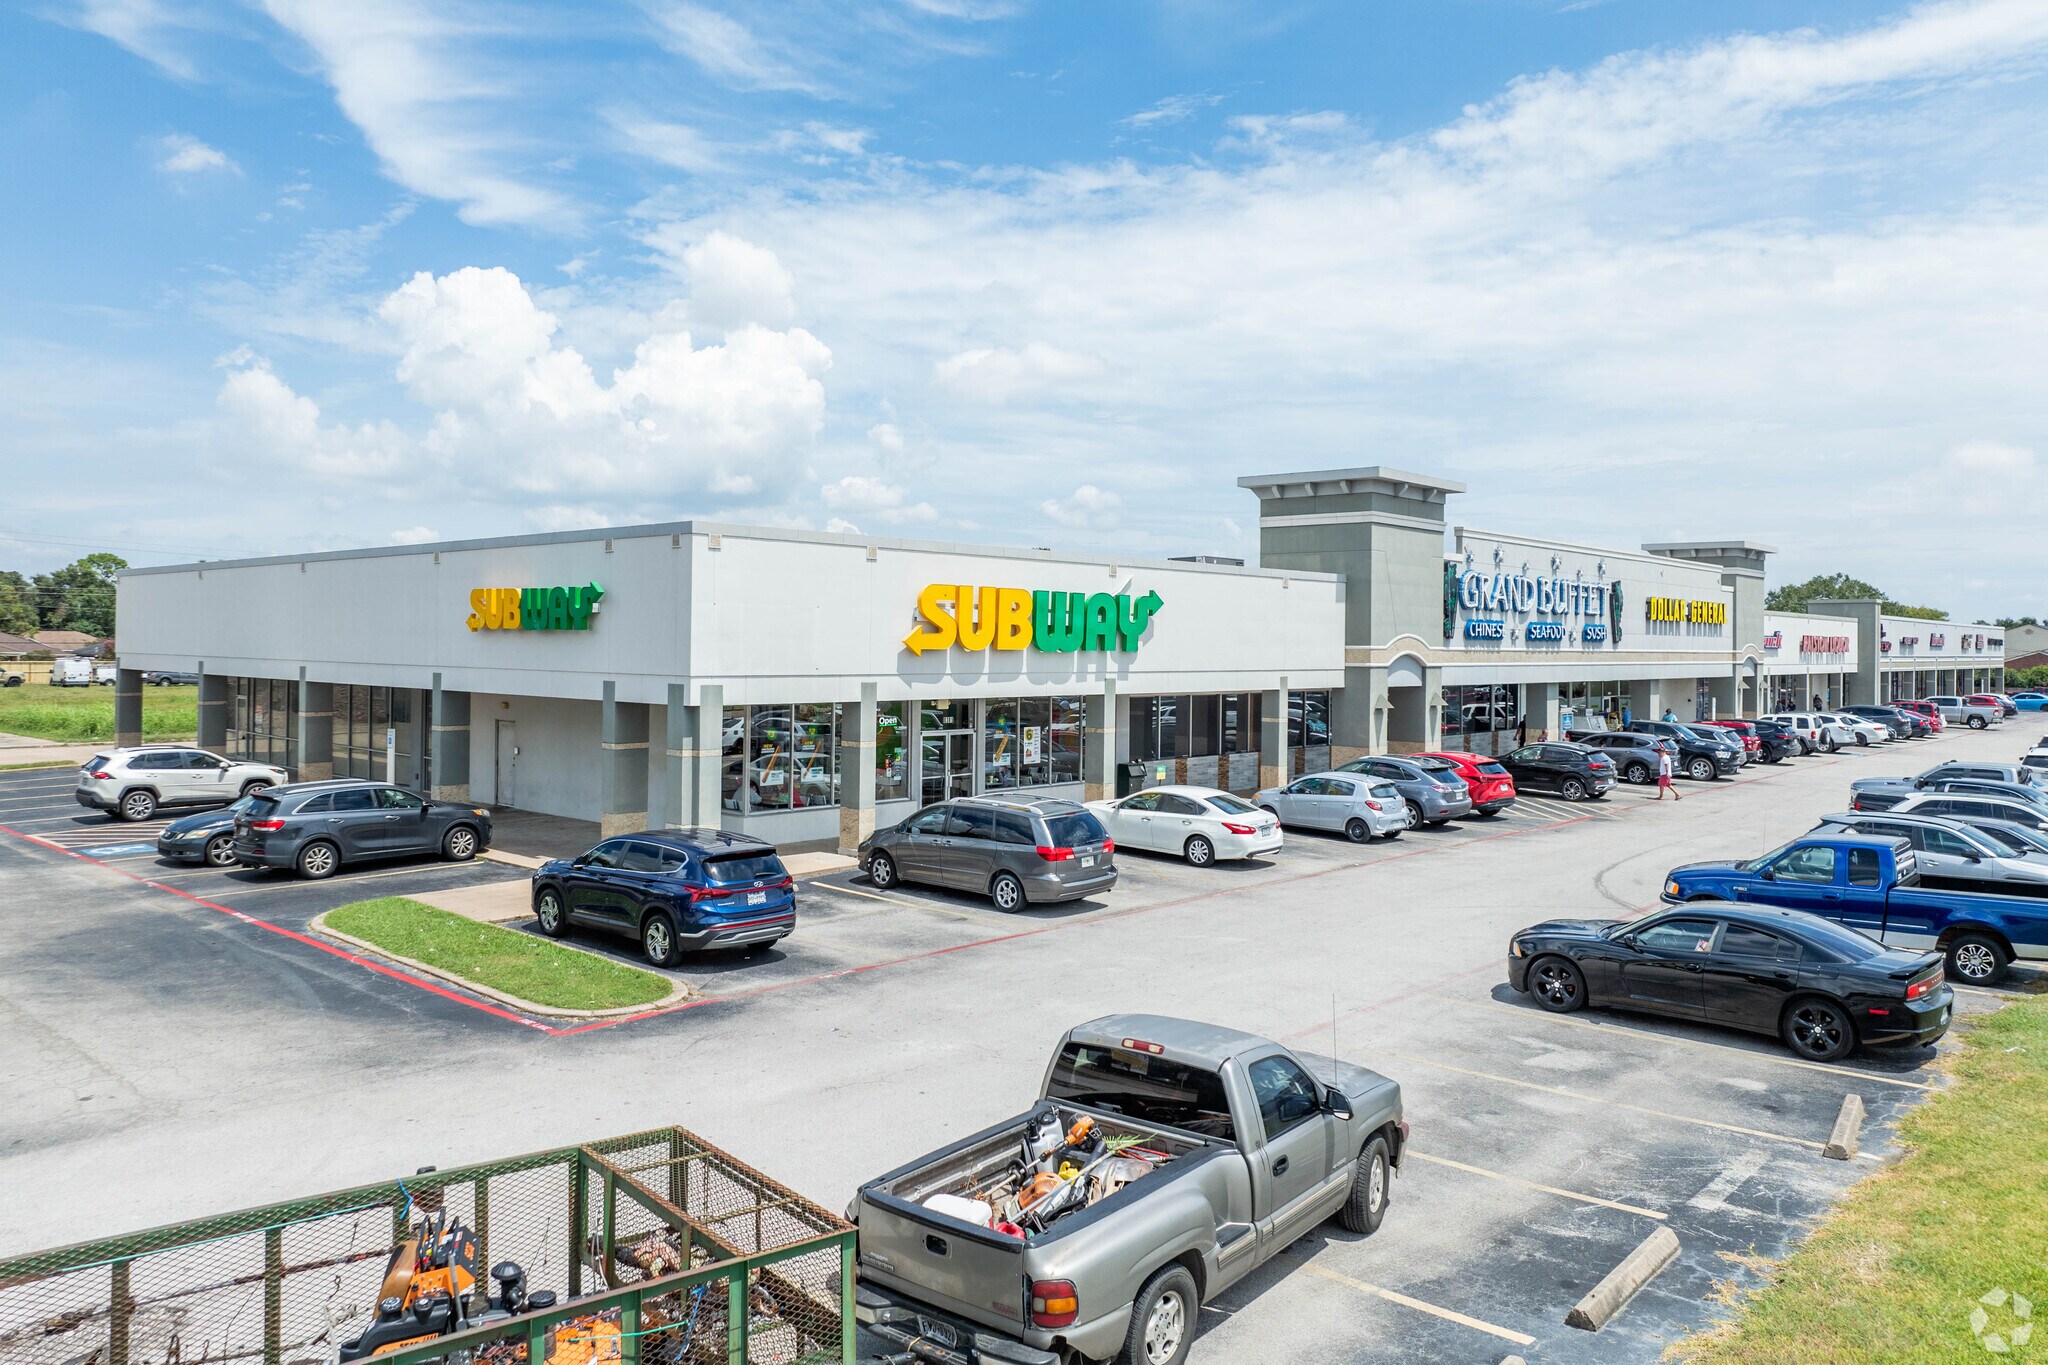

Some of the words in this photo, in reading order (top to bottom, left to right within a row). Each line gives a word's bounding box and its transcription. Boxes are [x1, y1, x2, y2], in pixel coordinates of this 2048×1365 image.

[466, 581, 605, 632] SUBWAY
[1459, 569, 1535, 614] GRAND
[1537, 576, 1611, 617] BUFFET
[1650, 597, 1686, 622] DOLLAR
[1691, 600, 1728, 624] GENERAL
[902, 584, 1164, 657] SUBWAY
[1531, 624, 1566, 639] SEAFOOD
[879, 717, 898, 726] Open
